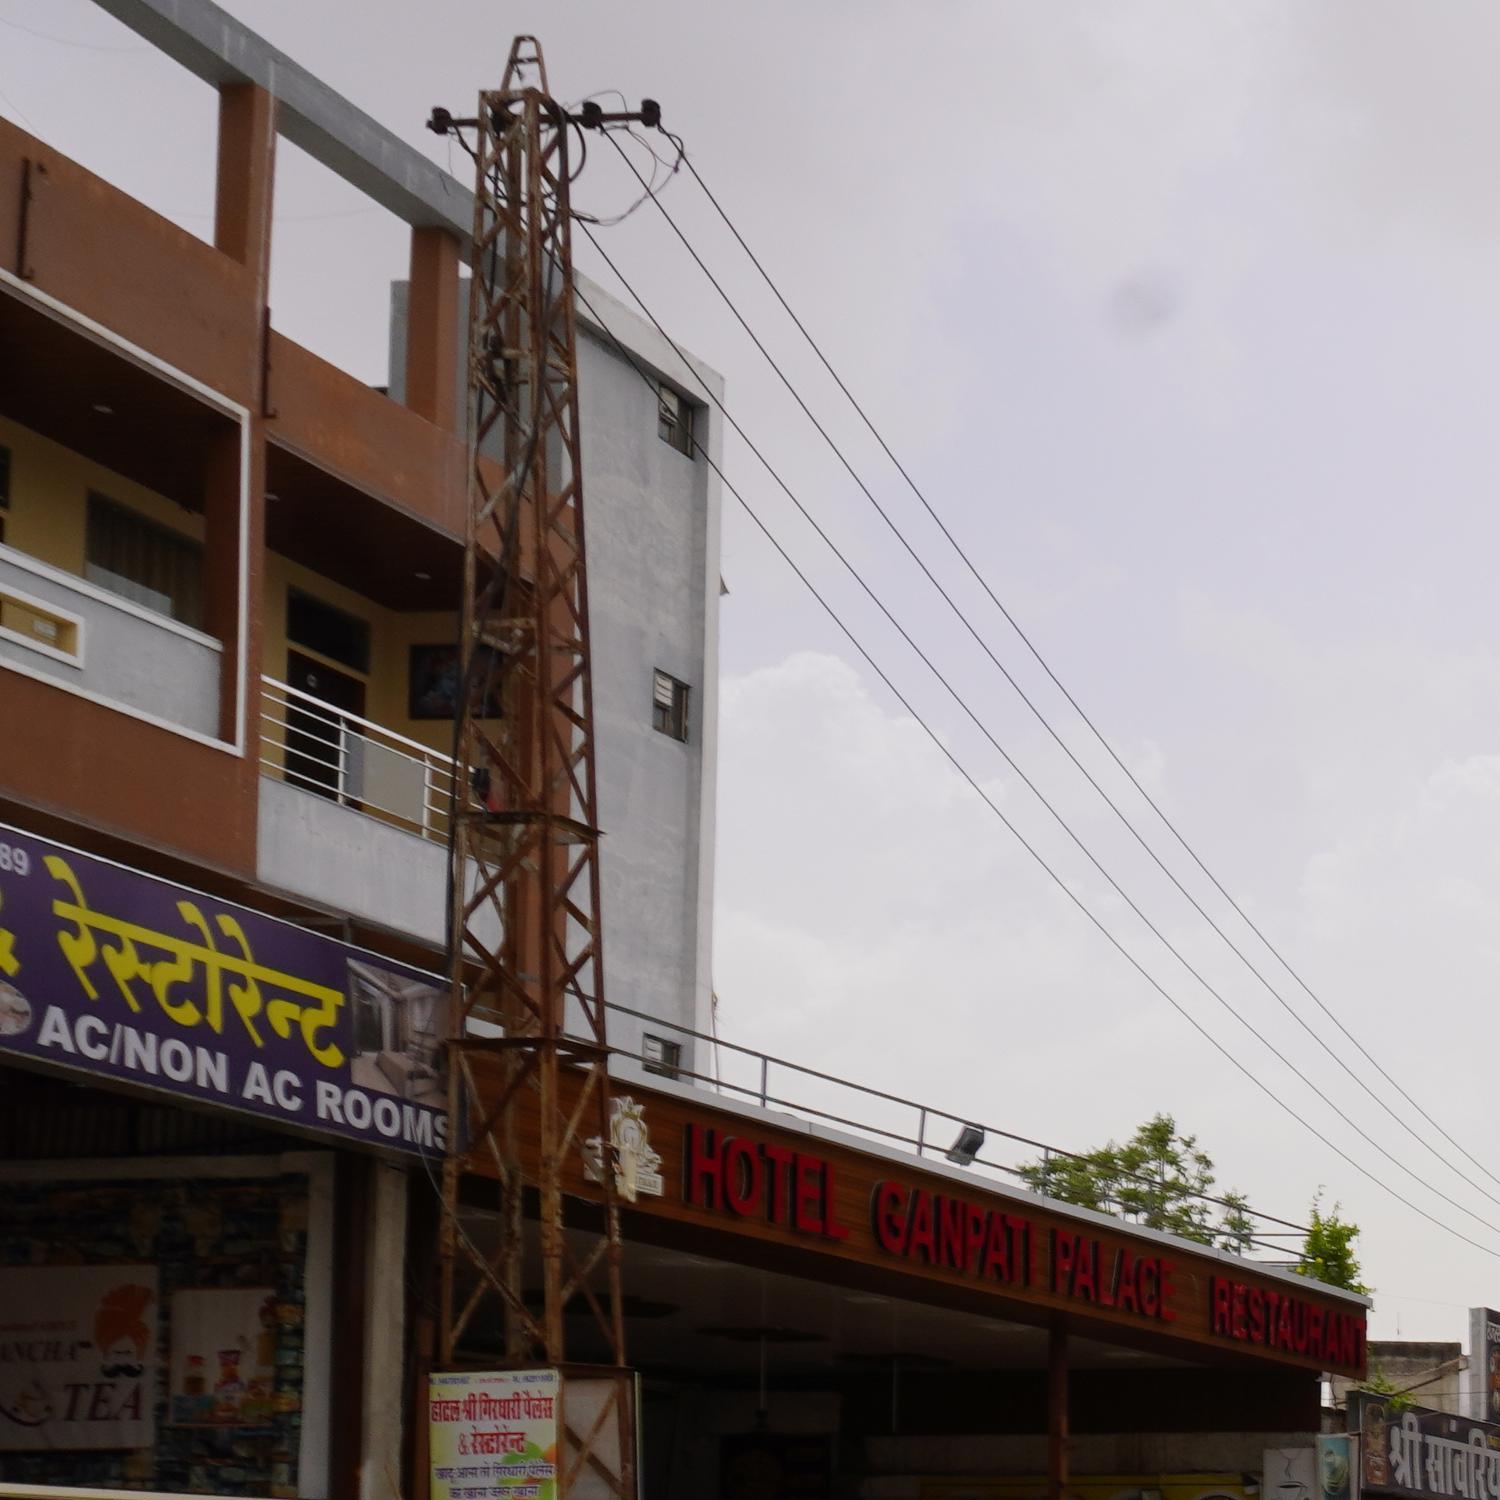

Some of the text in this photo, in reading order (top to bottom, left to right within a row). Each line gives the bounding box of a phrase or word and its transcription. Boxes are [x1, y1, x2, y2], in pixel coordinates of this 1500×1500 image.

[37, 1005, 452, 1150] AC/NON AC ROOMS
[684, 1121, 1367, 1369] HOTEL GANPATI PALACE RESTAURANT
[64, 1383, 143, 1421] TEA
[462, 1392, 477, 1420] श्री
[479, 1392, 520, 1421] गिरधारी
[458, 1433, 468, 1455] &
[1389, 1412, 1423, 1490] श्री
